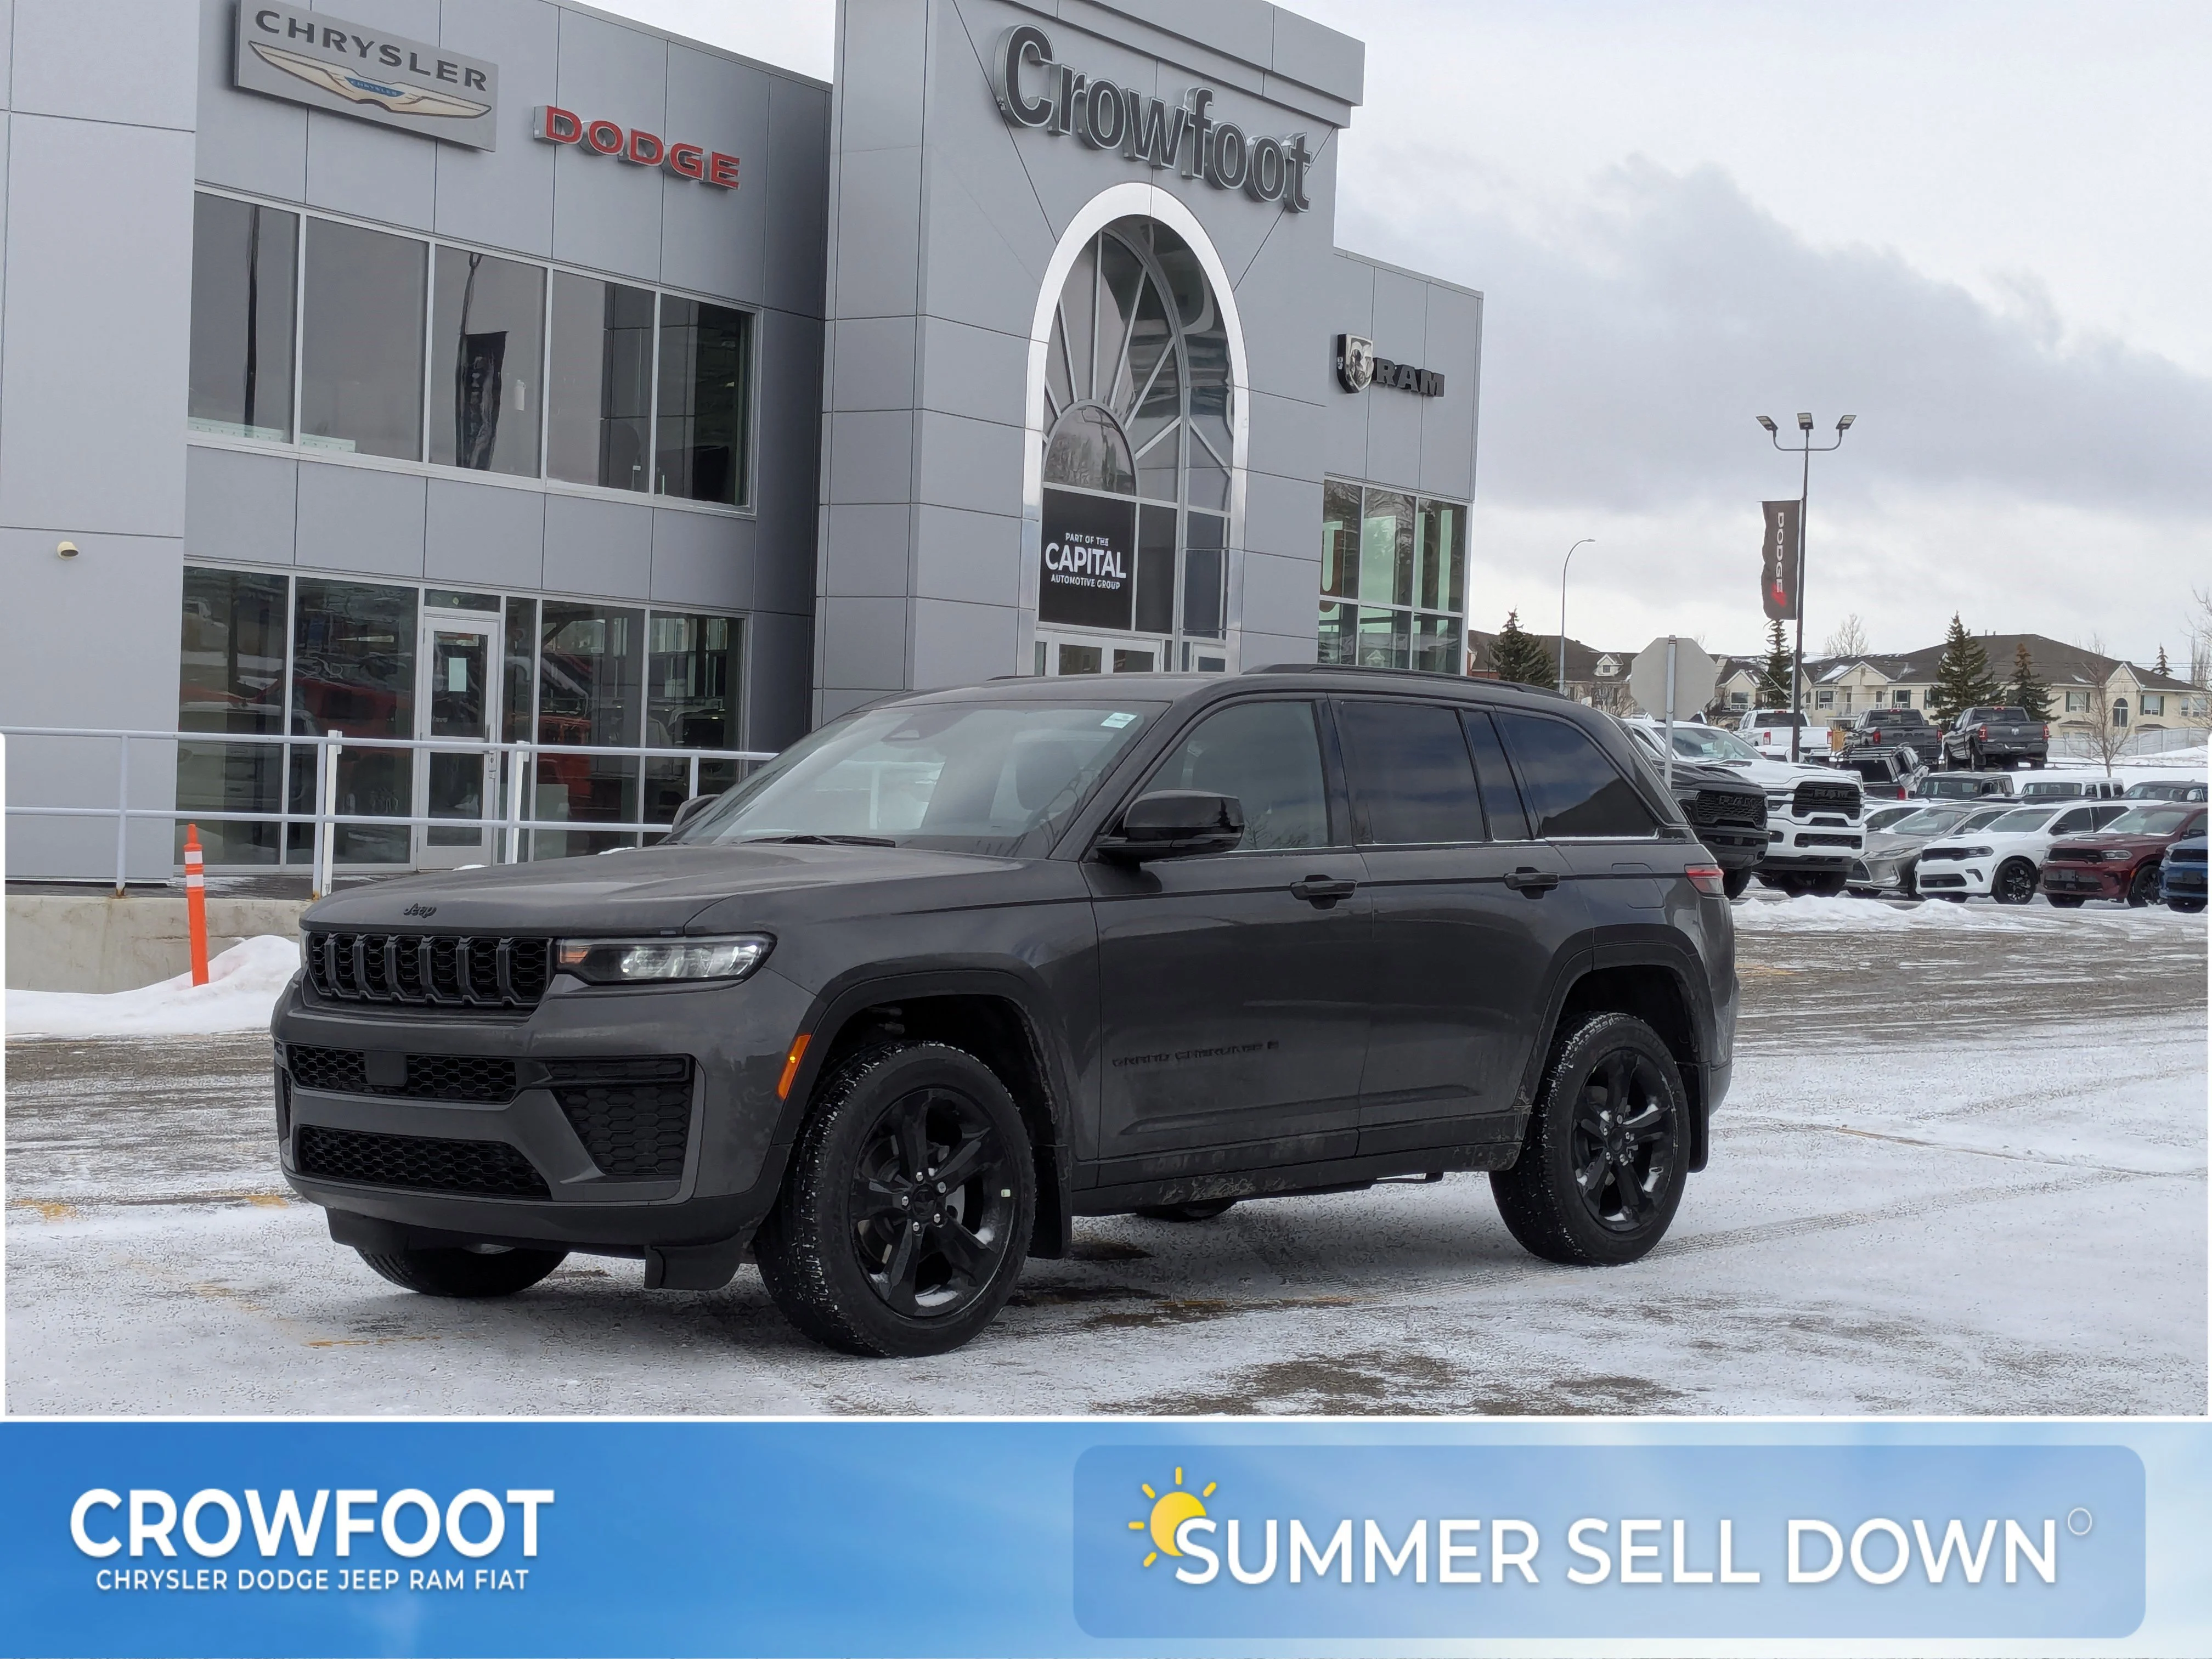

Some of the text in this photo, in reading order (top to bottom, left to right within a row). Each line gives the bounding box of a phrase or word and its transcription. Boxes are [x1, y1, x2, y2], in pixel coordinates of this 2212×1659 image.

[255, 10, 488, 92] CHRYSLER
[995, 24, 1313, 213] Crowfoot
[542, 106, 741, 190] DODGE
[1374, 357, 1445, 397] RAM
[1065, 532, 1109, 547] PART OF THE
[1775, 511, 1785, 593] DODGE
[1045, 543, 1126, 579] CAPITAL
[1051, 574, 1121, 590] AUTOMOTIVE GROUP
[403, 902, 437, 919] Jeep
